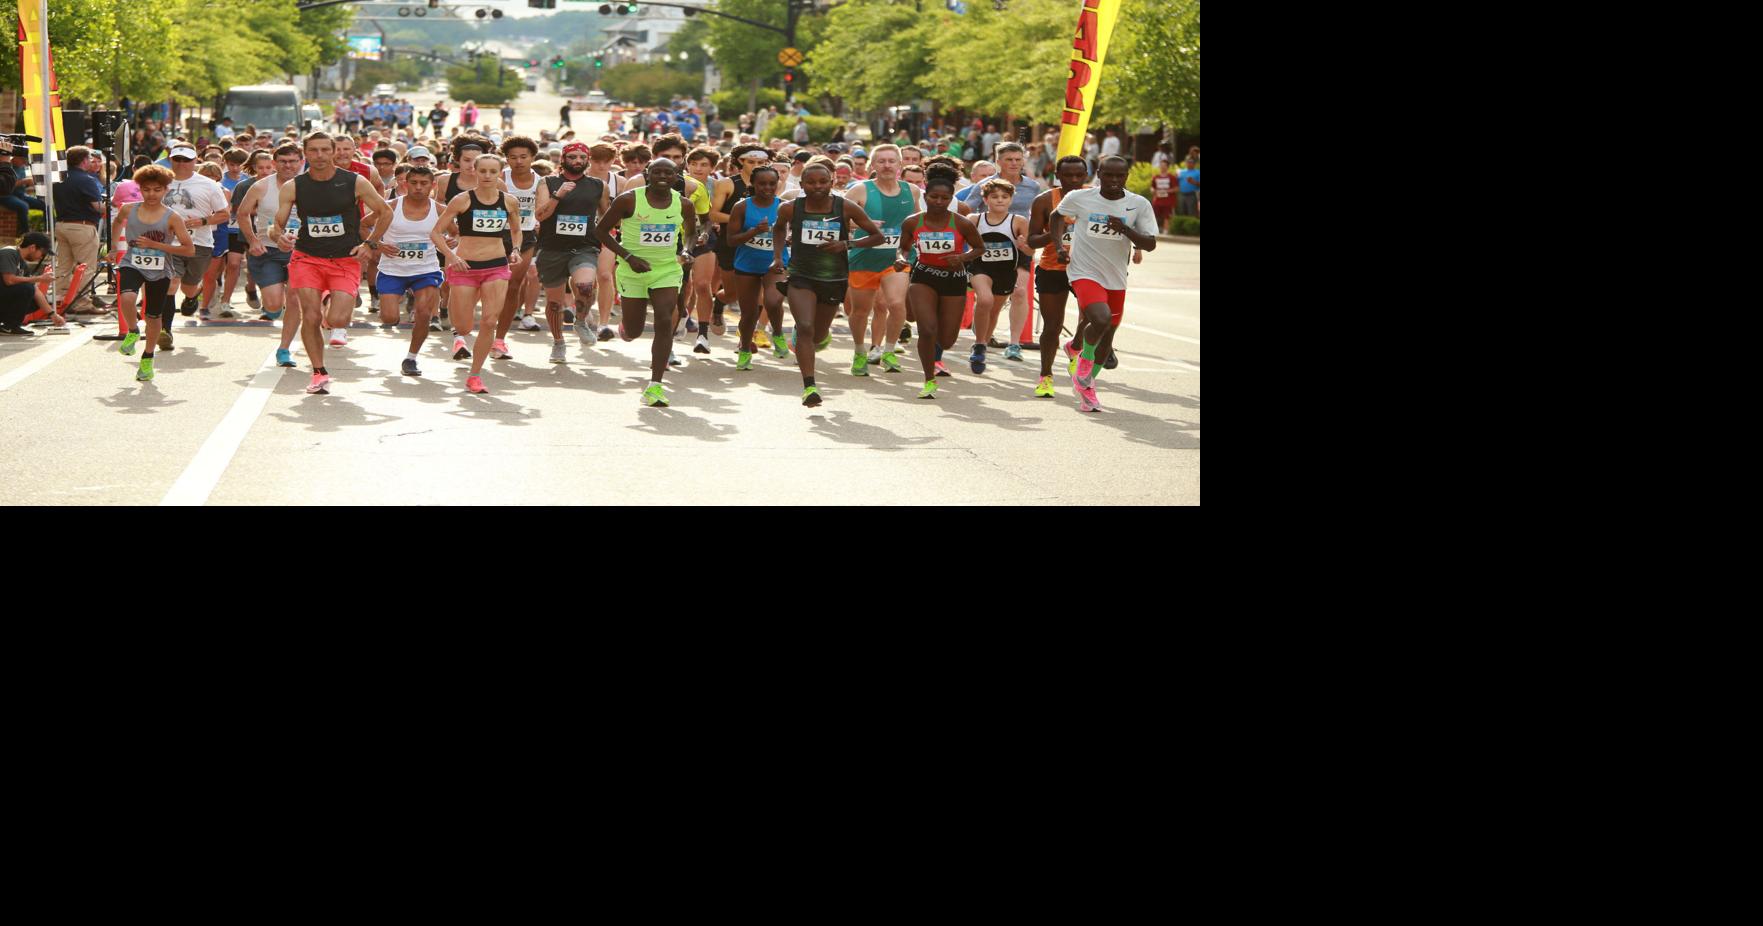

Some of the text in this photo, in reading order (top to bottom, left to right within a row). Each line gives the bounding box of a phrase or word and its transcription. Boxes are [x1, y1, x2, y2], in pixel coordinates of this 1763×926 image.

[1061, 0, 1100, 126] AR
[475, 218, 504, 229] 322
[559, 222, 584, 232] 299
[643, 232, 671, 243] 266
[807, 229, 835, 240] 145
[748, 237, 773, 247] 249
[882, 236, 900, 245] 47
[924, 240, 952, 250] 146
[398, 250, 424, 259] 498
[983, 248, 1009, 258] 333
[134, 256, 160, 266] 391
[925, 267, 949, 278] PRO
